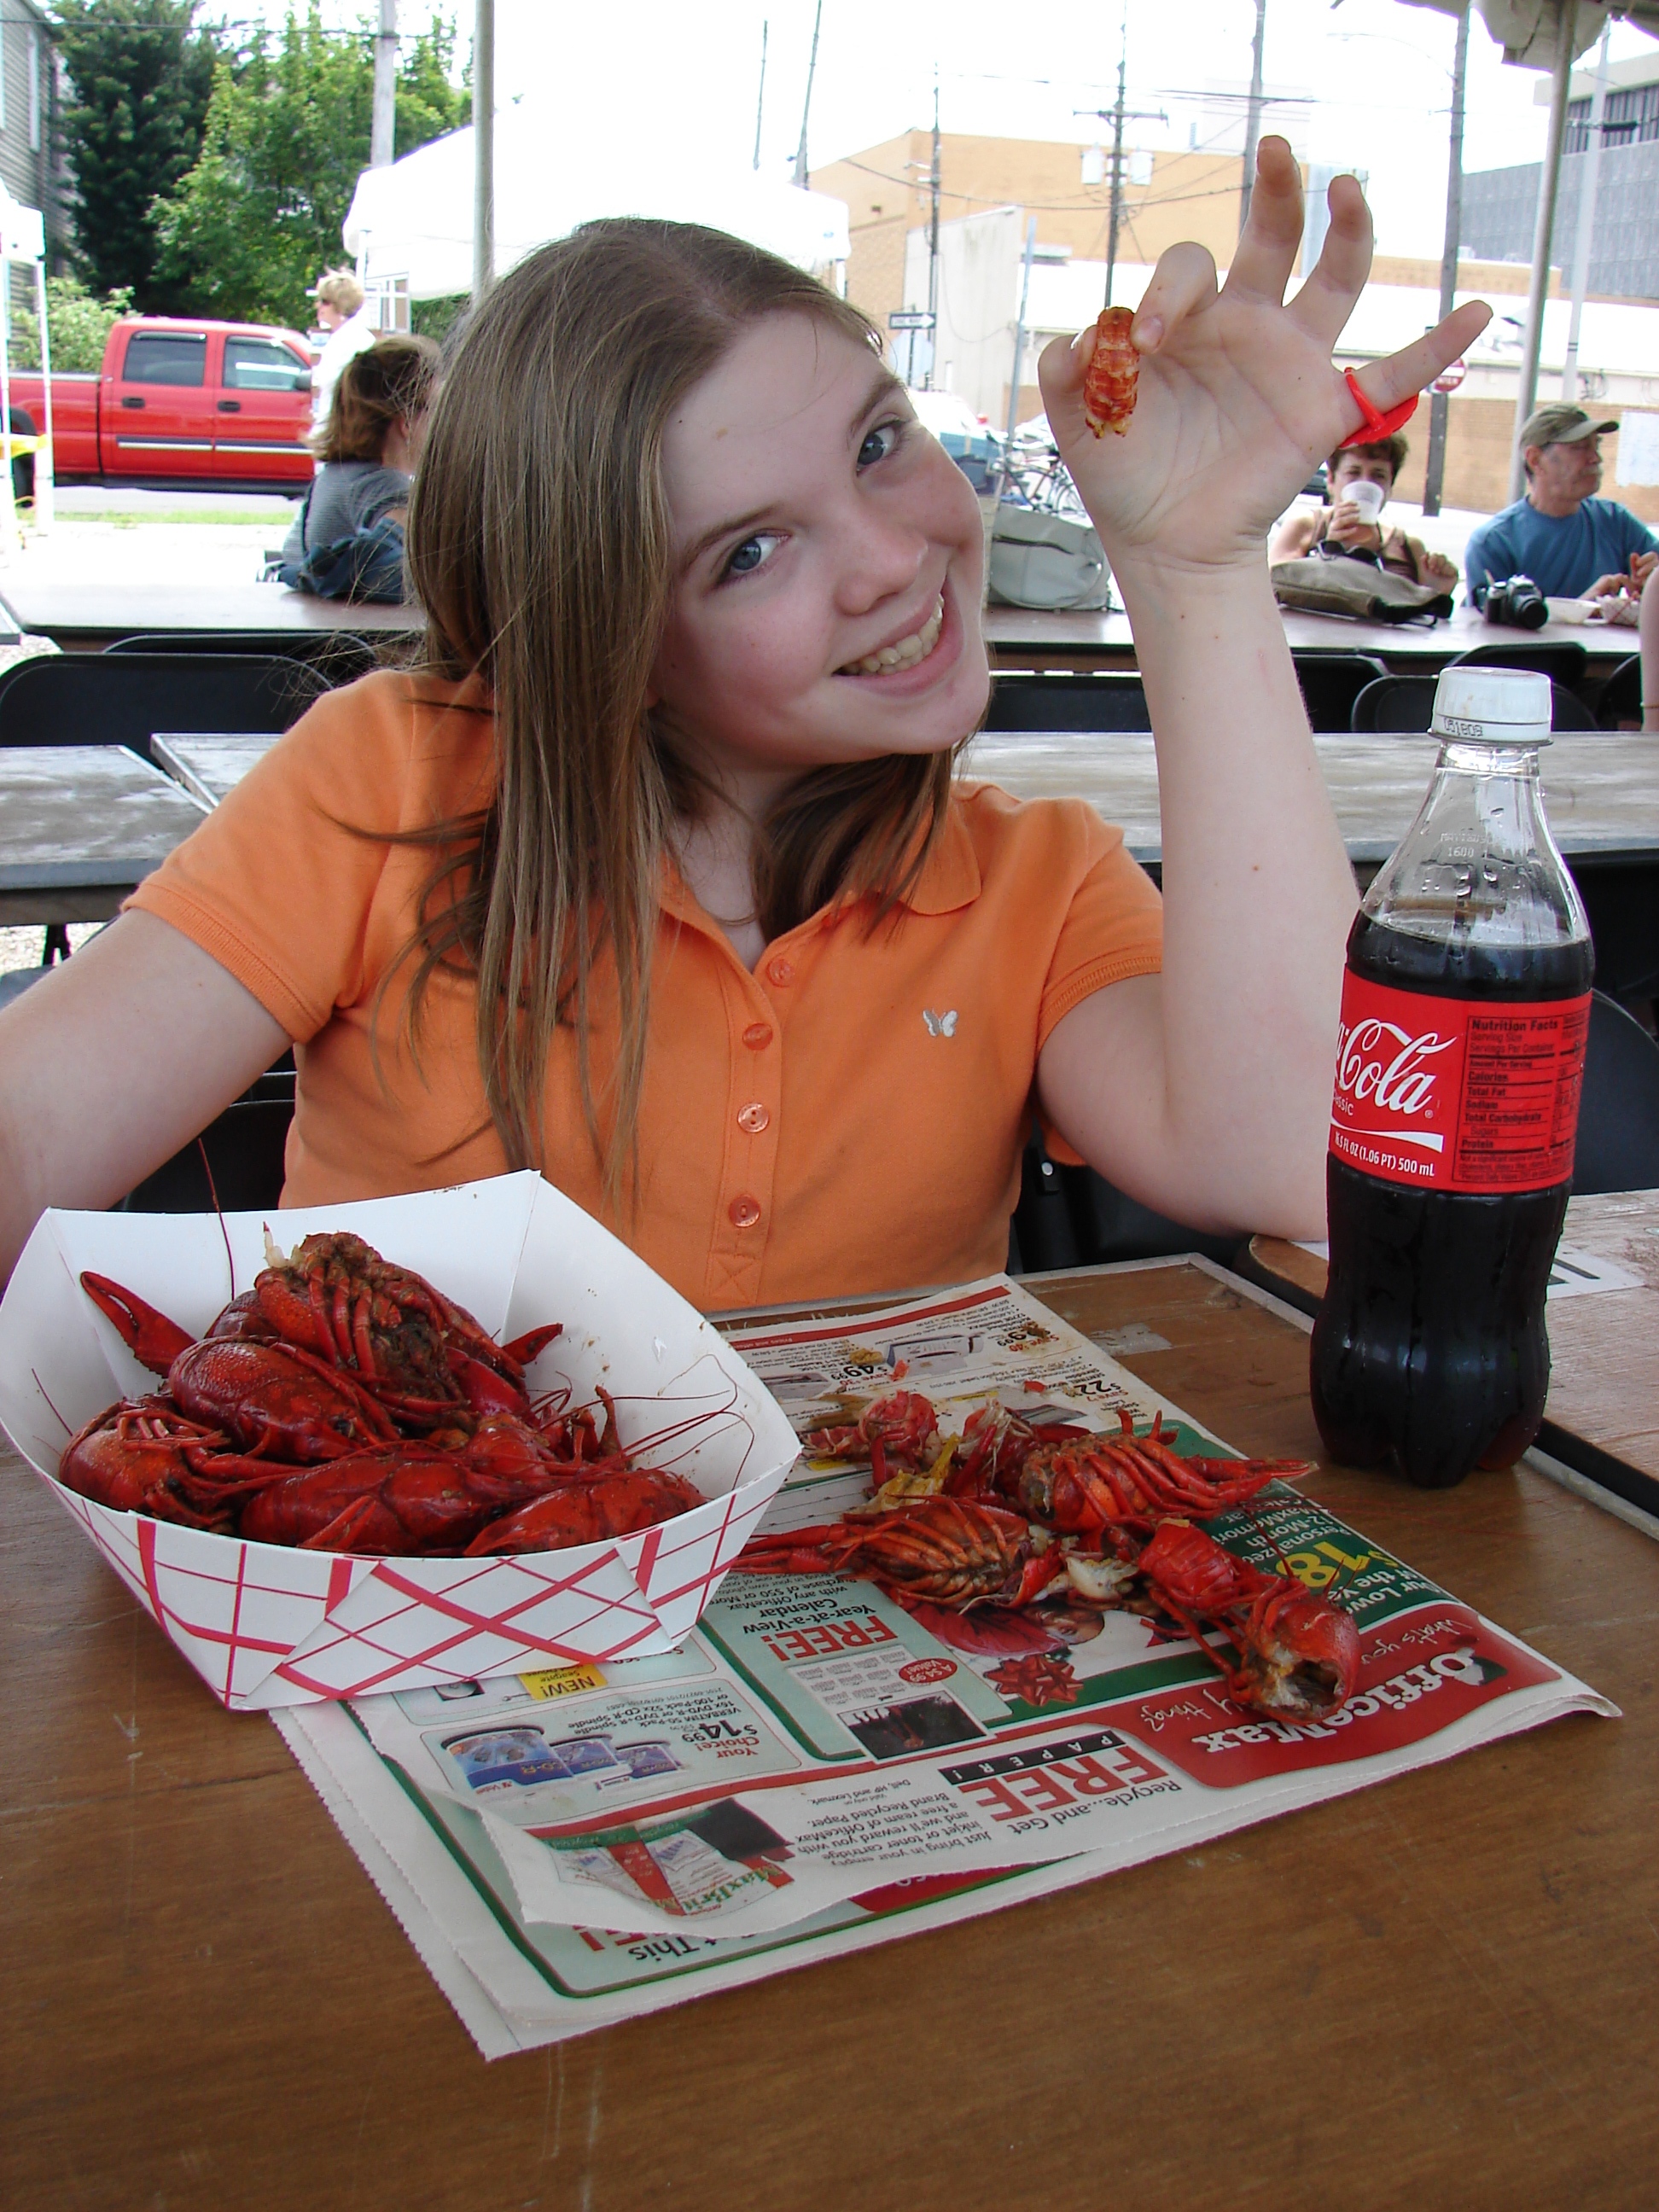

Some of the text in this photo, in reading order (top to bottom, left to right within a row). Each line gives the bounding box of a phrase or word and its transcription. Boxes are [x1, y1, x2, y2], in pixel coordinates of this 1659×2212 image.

[1472, 1019, 1527, 1031] Nutrition
[1530, 1020, 1558, 1031] Facts
[1470, 1033, 1504, 1043] Serving
[1469, 1071, 1509, 1082] Calories
[1467, 1086, 1505, 1096] Total Fat
[1465, 1099, 1499, 1109] Sodium
[1465, 1113, 1487, 1122] Total
[1470, 1126, 1499, 1137] Sugars
[1462, 1139, 1494, 1149] Protein
[1349, 1141, 1359, 1157] OZ
[1359, 1145, 1380, 1165] (1.06
[1381, 1153, 1397, 1171] PT)
[1397, 1157, 1417, 1174] 500
[1418, 1162, 1435, 1177] mL
[1031, 1335, 1060, 1347] Save
[1098, 1389, 1128, 1400] Save
[1245, 1514, 1333, 1550] 12-Month
[1353, 1570, 1395, 1589] the
[759, 1587, 784, 1598] $50
[785, 1585, 800, 1595] of
[708, 1595, 741, 1605] More
[726, 1586, 847, 1611] with any OfficeMax
[759, 1596, 837, 1619] Calendar
[742, 1603, 876, 1635] Year-at-a-View
[760, 1614, 898, 1662] FREE!
[1402, 1618, 1472, 1644] What's
[905, 1659, 941, 1675] Value!
[909, 1663, 952, 1683] A $4.99
[539, 1674, 596, 1697] NEW!
[642, 1704, 664, 1713] 52x
[666, 1697, 714, 1710] 100-Pack
[675, 1703, 713, 1714] DVD-R
[713, 1700, 735, 1709] 16x
[613, 1707, 641, 1718] CD-R
[619, 1713, 659, 1725] DVD+R
[683, 1706, 742, 1721] VERBATIM
[1139, 1701, 1204, 1732] thing?
[567, 1714, 611, 1730] Spindle
[573, 1720, 617, 1736] Spindle
[638, 1715, 682, 1728] 50-Pack
[694, 1736, 760, 1751] Choice!
[716, 1748, 758, 1758] Your
[888, 1778, 911, 1789] Dell,
[957, 1745, 1169, 1822] FREE
[807, 1792, 852, 1805] Lexmark.
[853, 1788, 871, 1797] and
[806, 1792, 950, 1829] Brand Recycled Paper.
[1007, 1779, 1182, 1835] Recycle...and Get
[795, 1802, 958, 1844] a free ream of OfficeMax
[797, 1810, 969, 1856] and we'll reward you with
[821, 1819, 982, 1861] inkjet or toner cartridge
[830, 1831, 992, 1867] Just bring in your empty
[628, 1936, 700, 1962] This
